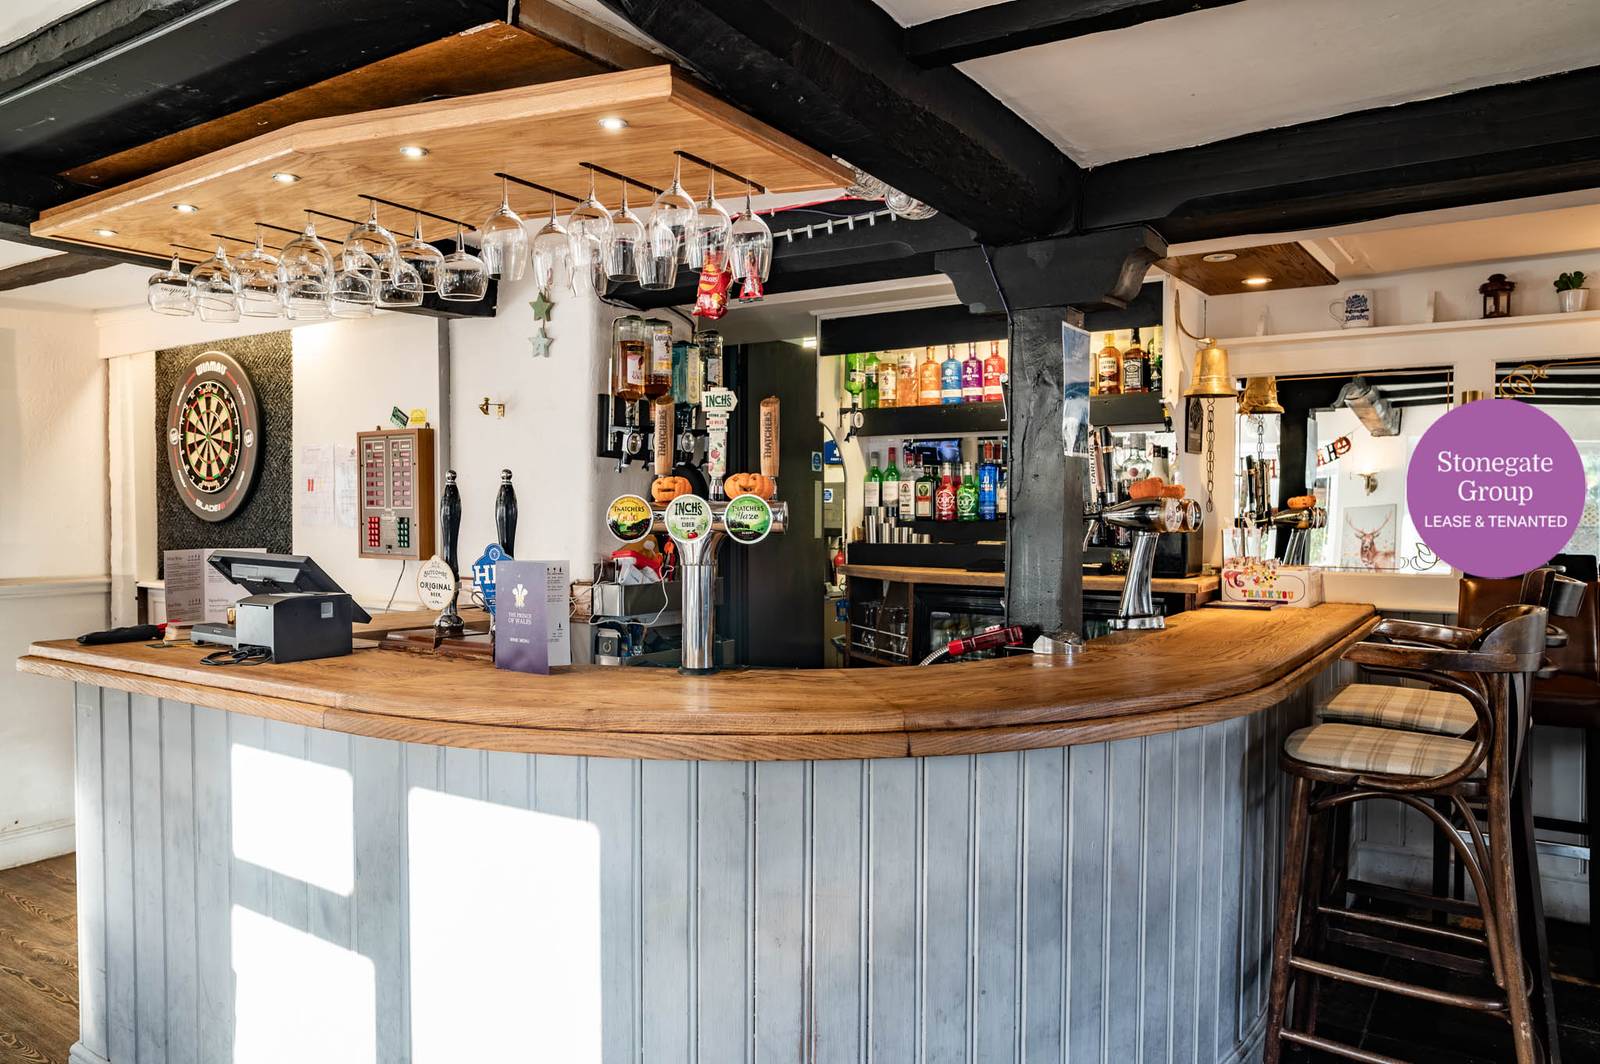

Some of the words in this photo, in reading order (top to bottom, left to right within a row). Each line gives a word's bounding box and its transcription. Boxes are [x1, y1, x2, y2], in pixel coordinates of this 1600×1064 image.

[195, 360, 228, 376] WINMAU
[658, 409, 668, 456] THATCHERS
[764, 411, 773, 458] THATCHERS
[1088, 443, 1097, 485] CARLING
[735, 511, 759, 521] Haze
[420, 581, 452, 592] ORIGINAL
[1241, 589, 1275, 599] THANK
[1276, 590, 1294, 600] YOU
[515, 617, 532, 625] WALES
